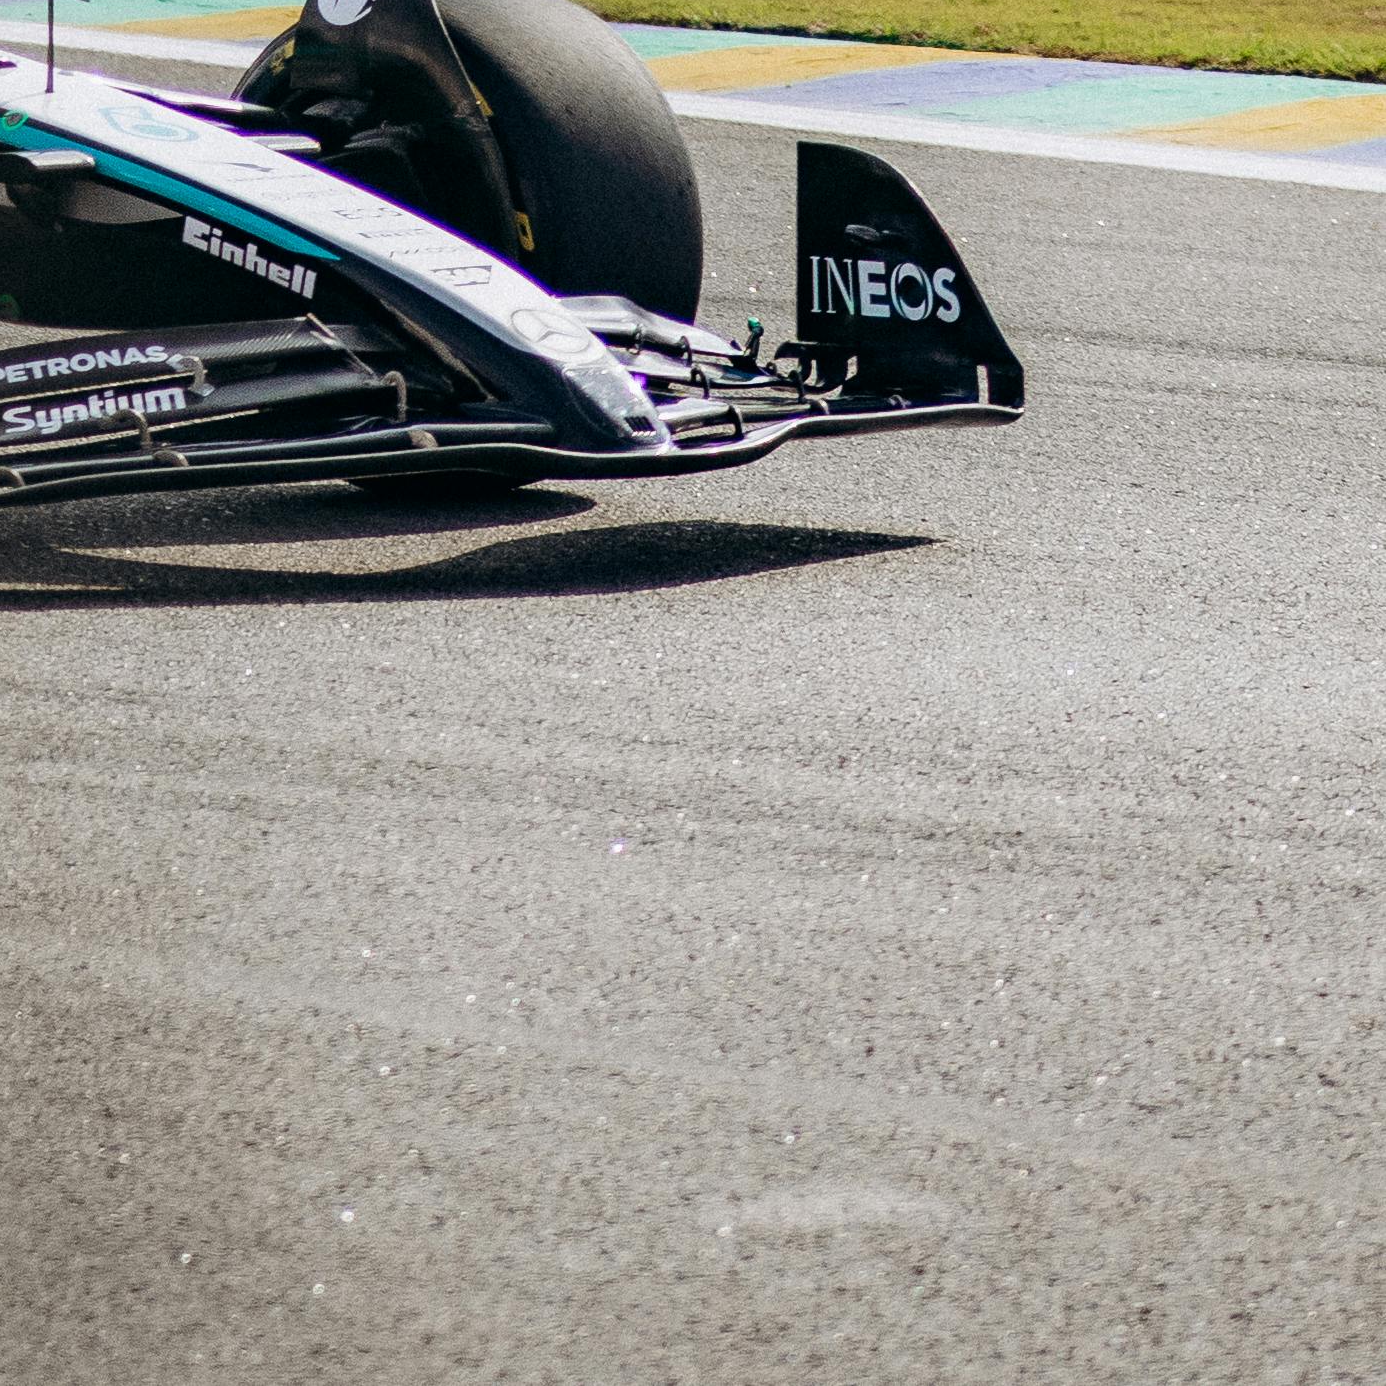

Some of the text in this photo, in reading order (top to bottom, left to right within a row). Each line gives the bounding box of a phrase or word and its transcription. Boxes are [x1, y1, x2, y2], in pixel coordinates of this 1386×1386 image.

[181, 214, 317, 300] Einhell
[809, 256, 961, 323] INEOS
[2, 388, 187, 435] Syntium
